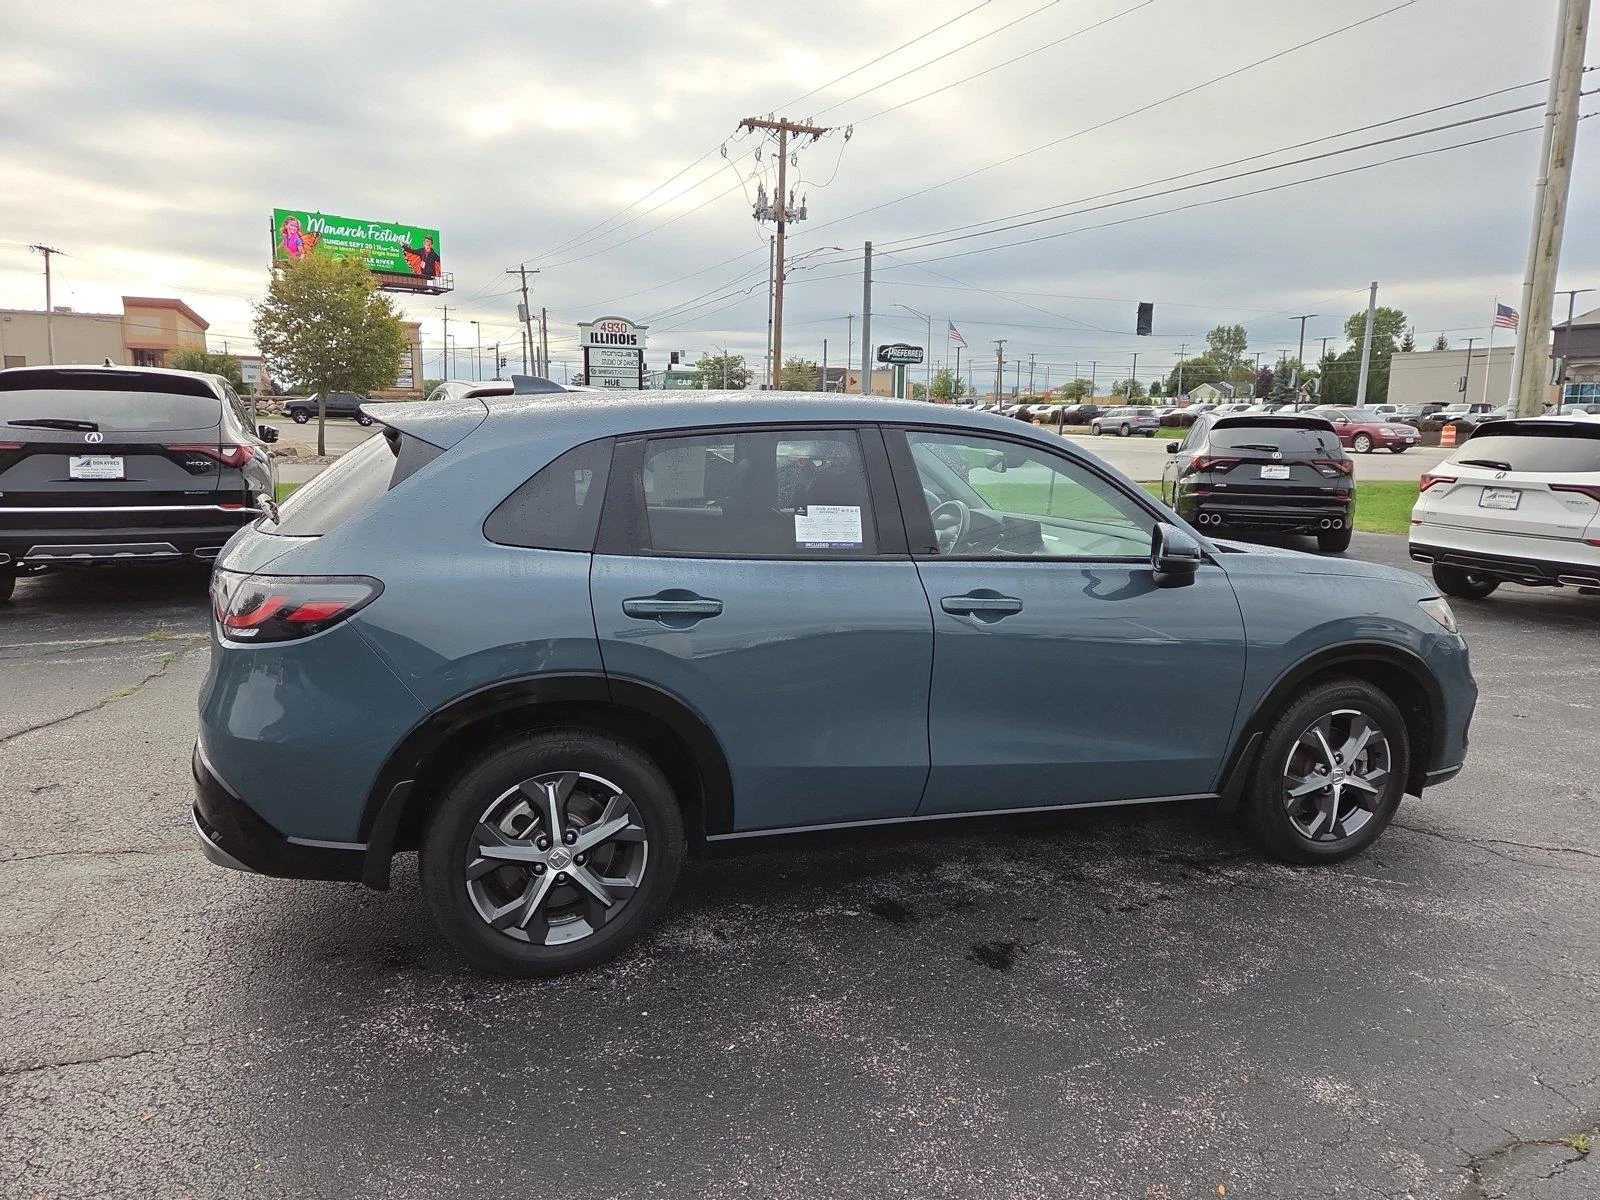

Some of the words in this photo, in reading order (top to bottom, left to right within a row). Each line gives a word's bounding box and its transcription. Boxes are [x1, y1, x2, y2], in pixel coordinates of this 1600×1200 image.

[306, 214, 366, 239] Monarch
[367, 223, 412, 245] Festival
[375, 258, 395, 266] RIVER
[600, 322, 627, 333] 4930
[590, 332, 637, 345] ILLINOIS
[604, 379, 621, 387] HUE
